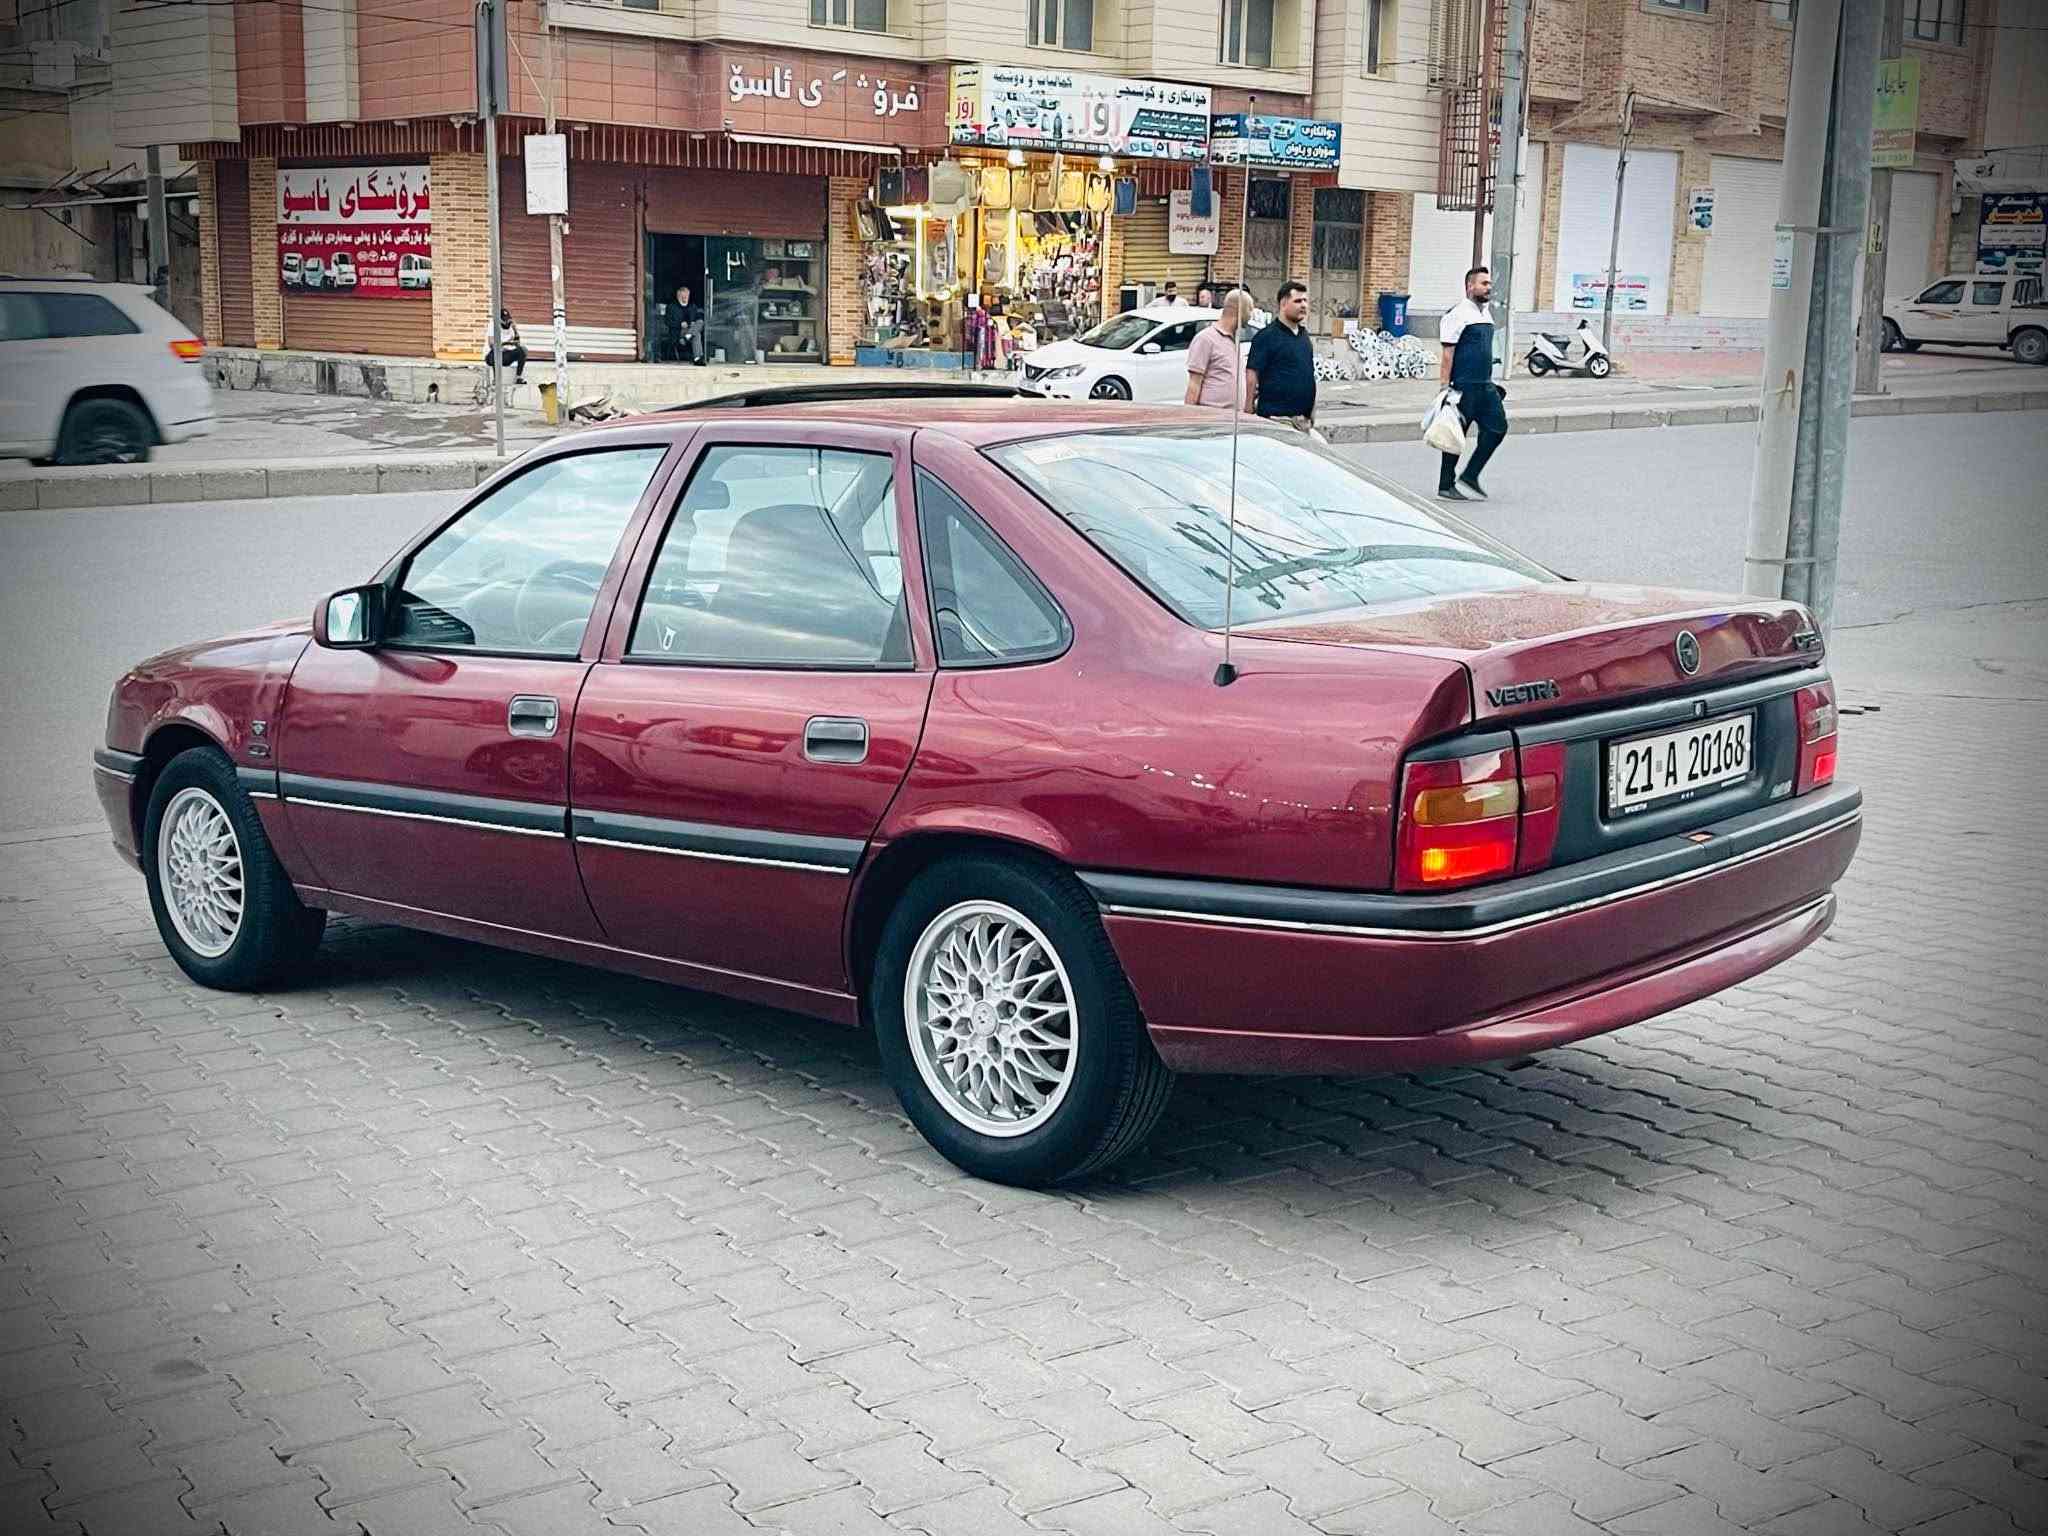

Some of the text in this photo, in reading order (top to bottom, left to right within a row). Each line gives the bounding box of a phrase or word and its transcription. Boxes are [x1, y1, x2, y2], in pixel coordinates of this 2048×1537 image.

[1485, 679, 1561, 708] VECTRA
[1624, 745, 1654, 796] 21
[1664, 740, 1678, 788] A
[1687, 723, 1746, 782] 20168
